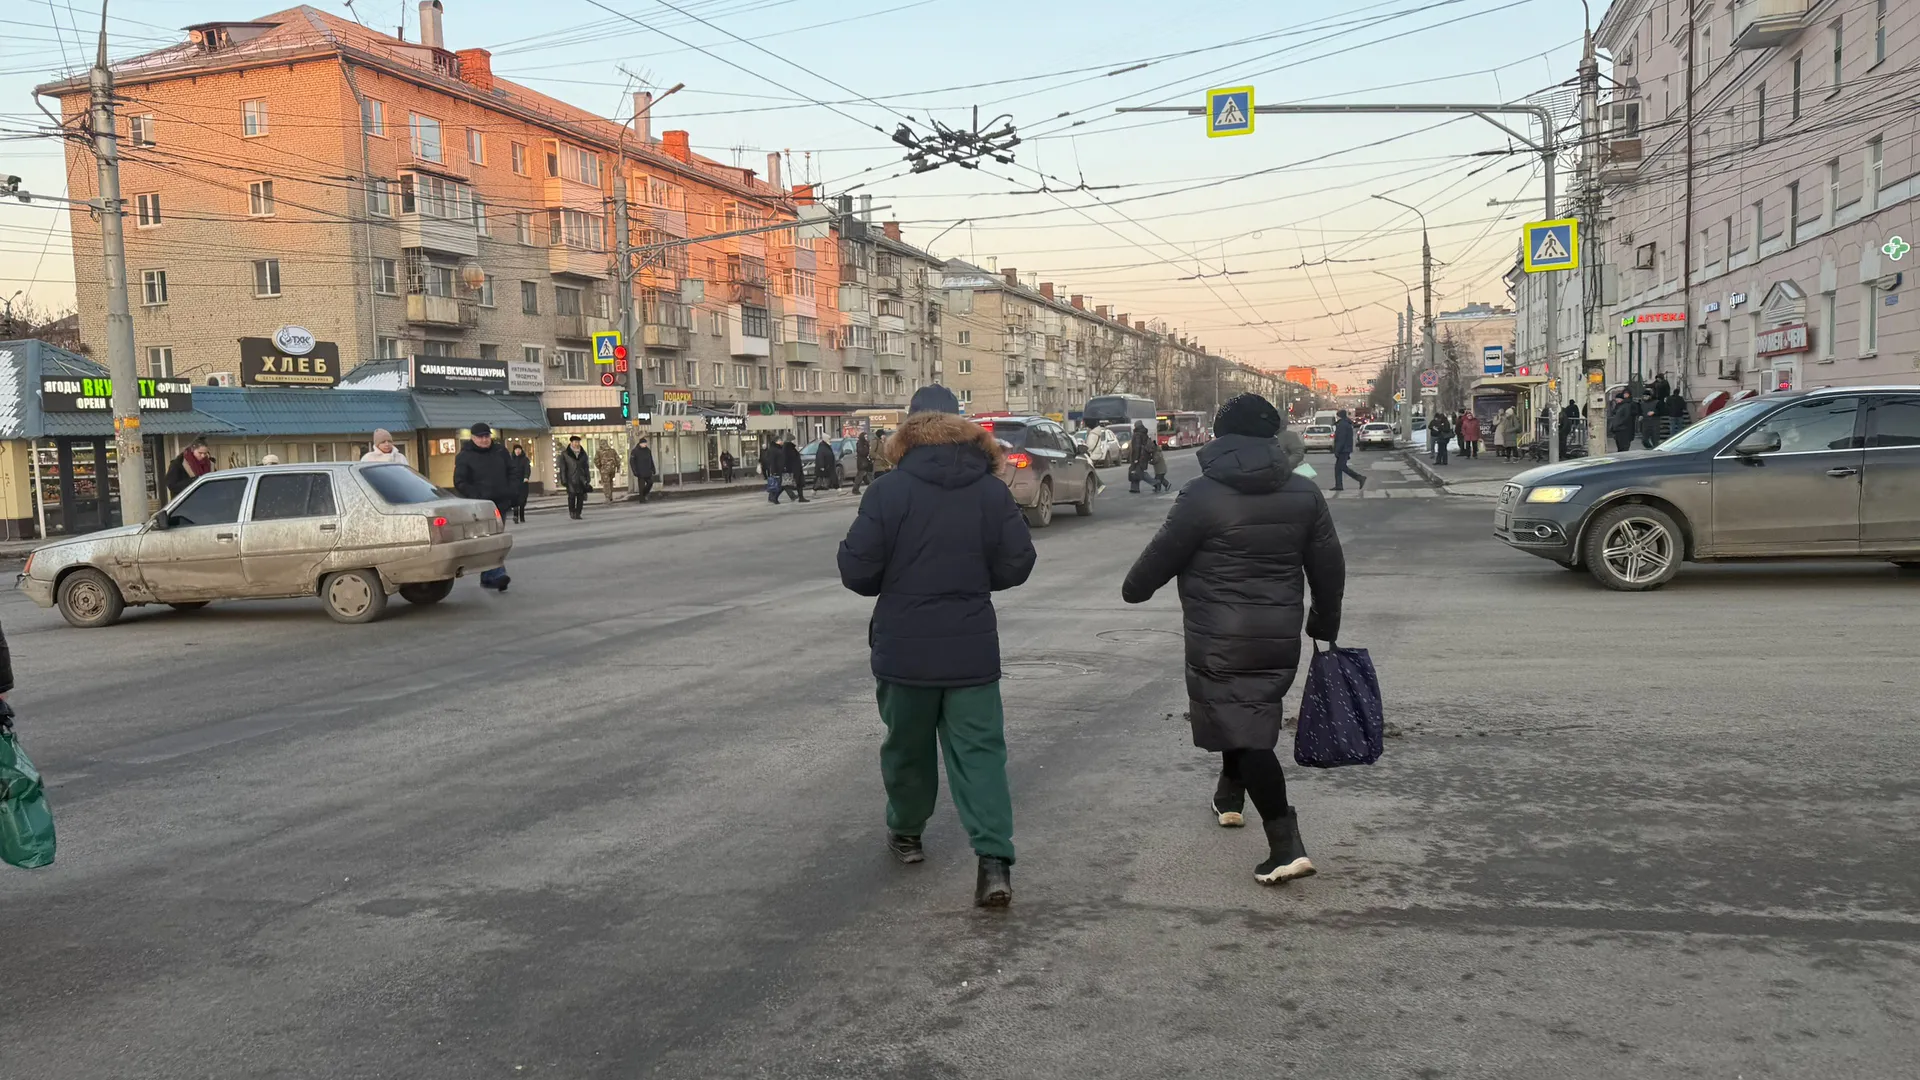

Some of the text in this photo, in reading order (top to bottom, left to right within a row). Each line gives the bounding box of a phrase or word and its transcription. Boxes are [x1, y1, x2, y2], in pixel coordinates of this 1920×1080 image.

[1637, 312, 1686, 323] АПТЕКА
[261, 356, 327, 373] ХЛЕБ
[420, 364, 446, 375] САМАЯ
[446, 365, 477, 377] ВКУСНАЯ
[615, 359, 628, 372] 20
[44, 381, 81, 394] ЯГОДЫ
[156, 382, 192, 394] ФРУКТЫ
[664, 391, 692, 401] ПОДАРКИ
[76, 397, 107, 409] ОРЕХИ
[563, 412, 606, 422] Пекарня
